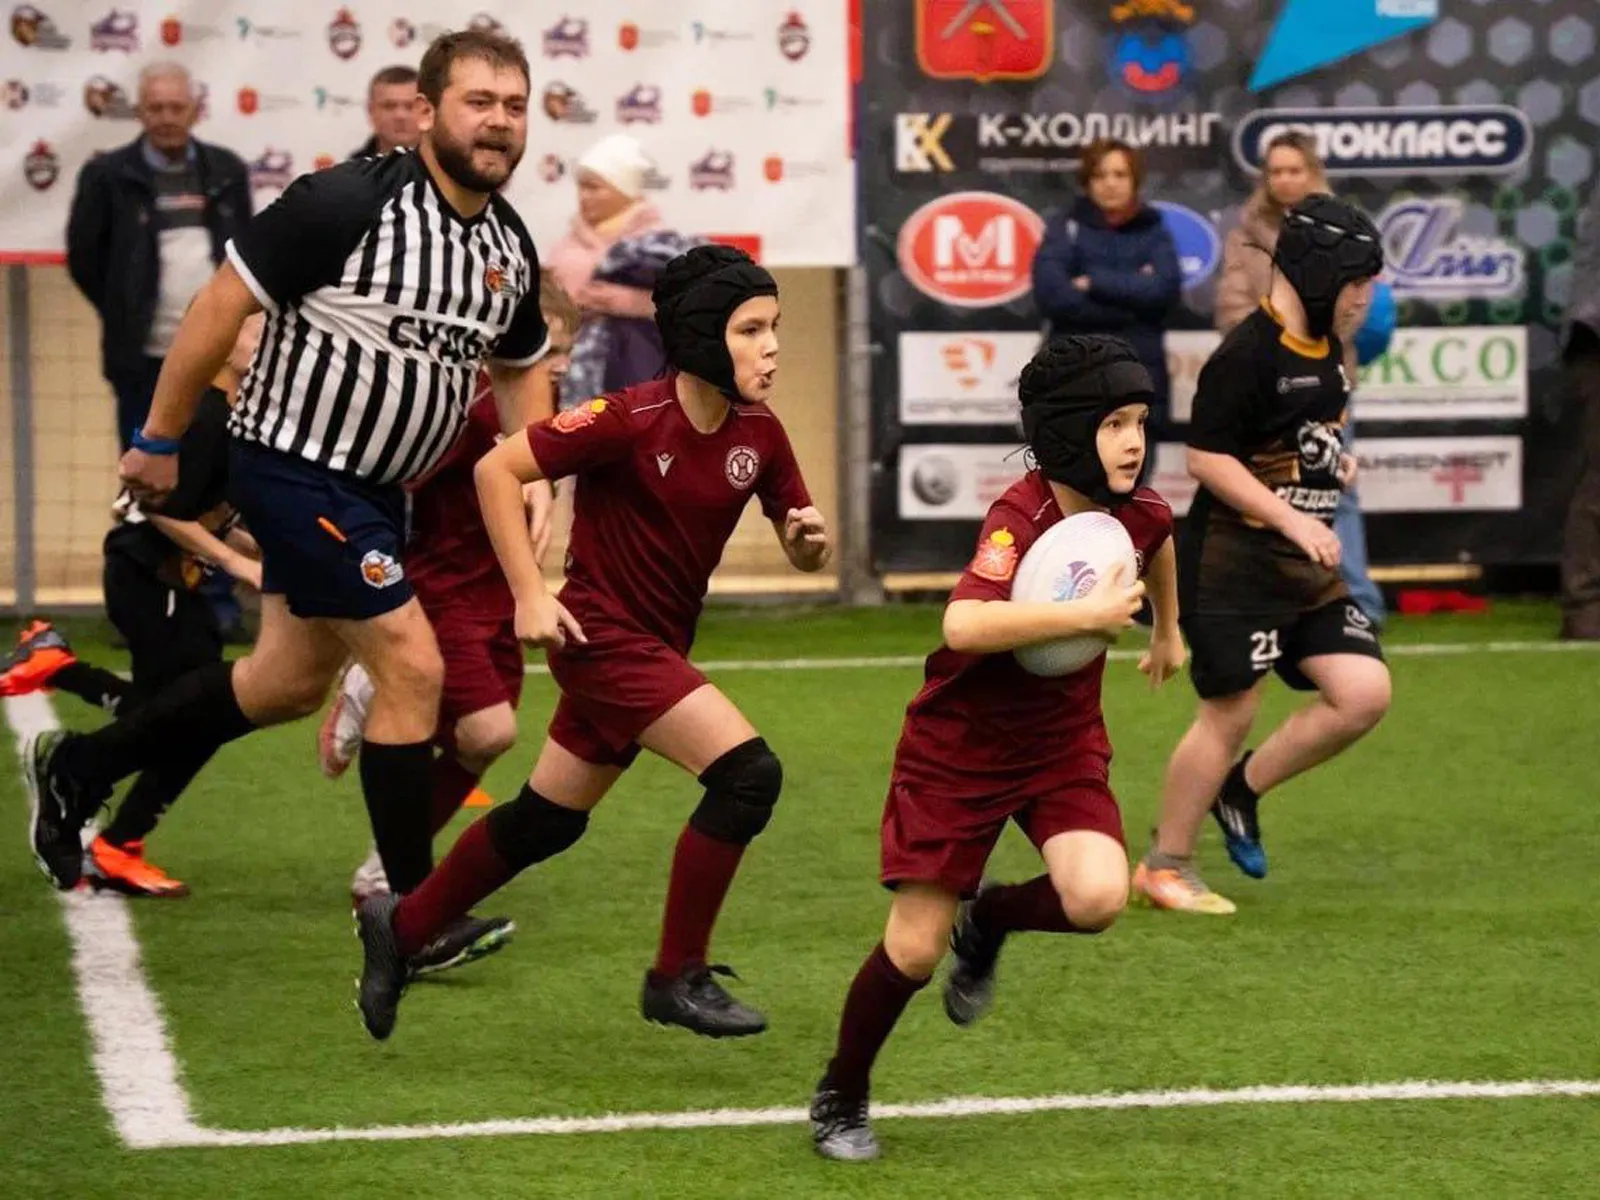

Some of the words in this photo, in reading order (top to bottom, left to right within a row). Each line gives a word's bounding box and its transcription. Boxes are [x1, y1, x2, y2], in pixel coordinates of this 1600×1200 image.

[978, 111, 1222, 149] К-ХОЛДИНГ
[1258, 119, 1508, 159] ТОКЛАСС
[1357, 336, 1518, 384] КСО
[1250, 628, 1283, 662] 21
